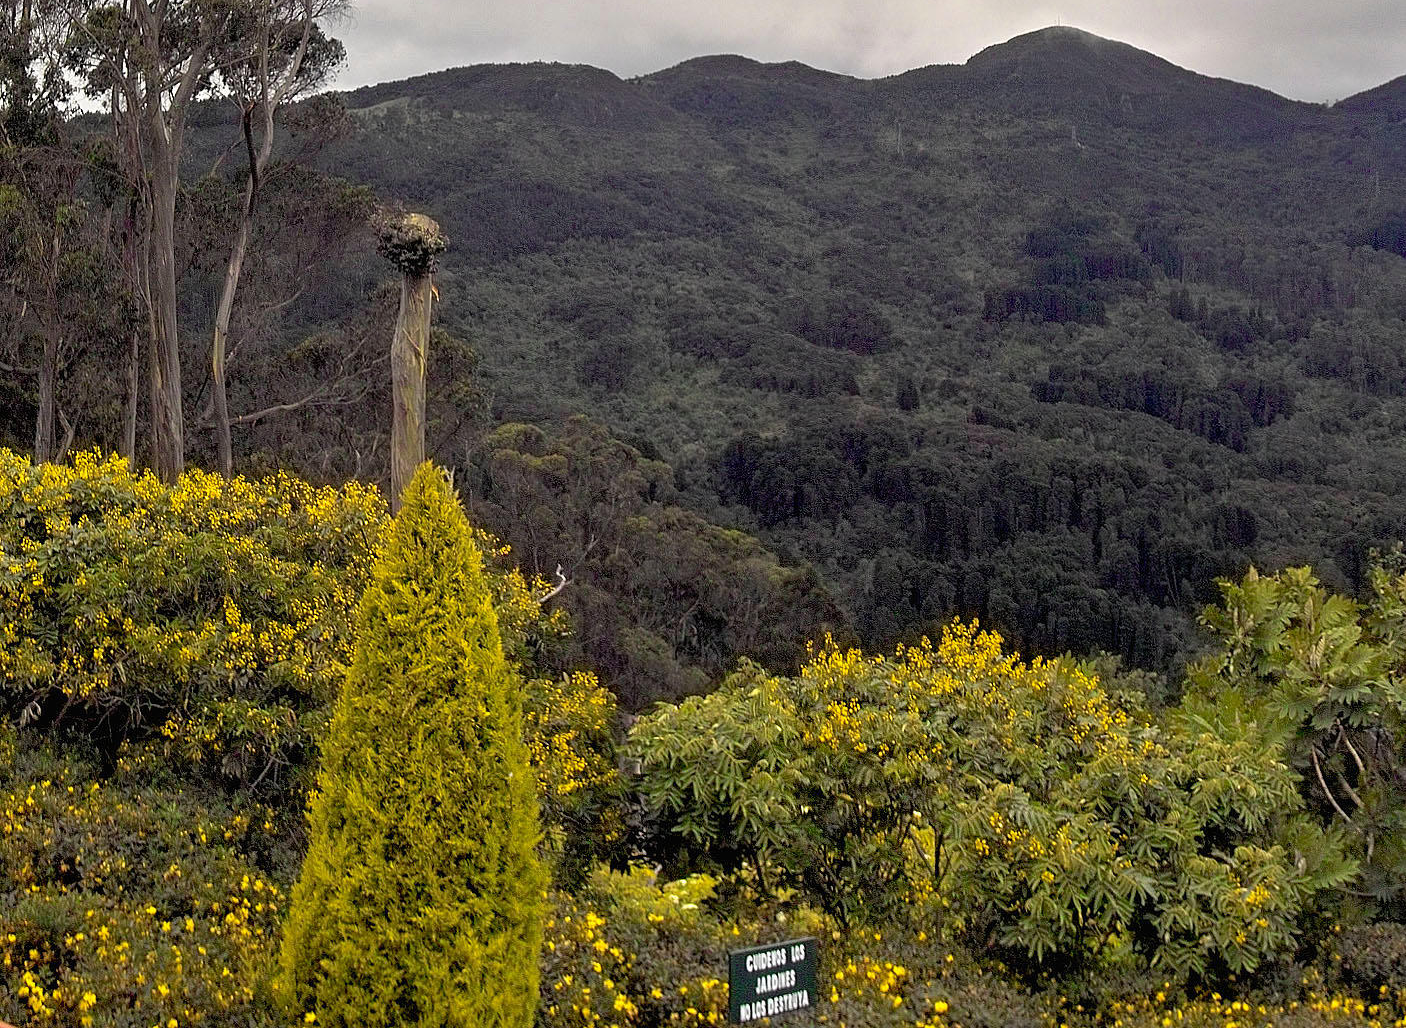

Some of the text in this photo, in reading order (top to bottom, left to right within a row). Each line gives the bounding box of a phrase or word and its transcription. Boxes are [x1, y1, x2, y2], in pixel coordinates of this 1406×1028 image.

[791, 944, 805, 963] LOS
[755, 969, 796, 994] JARDINES
[740, 990, 809, 1022] NO LOS DESTRUYA
